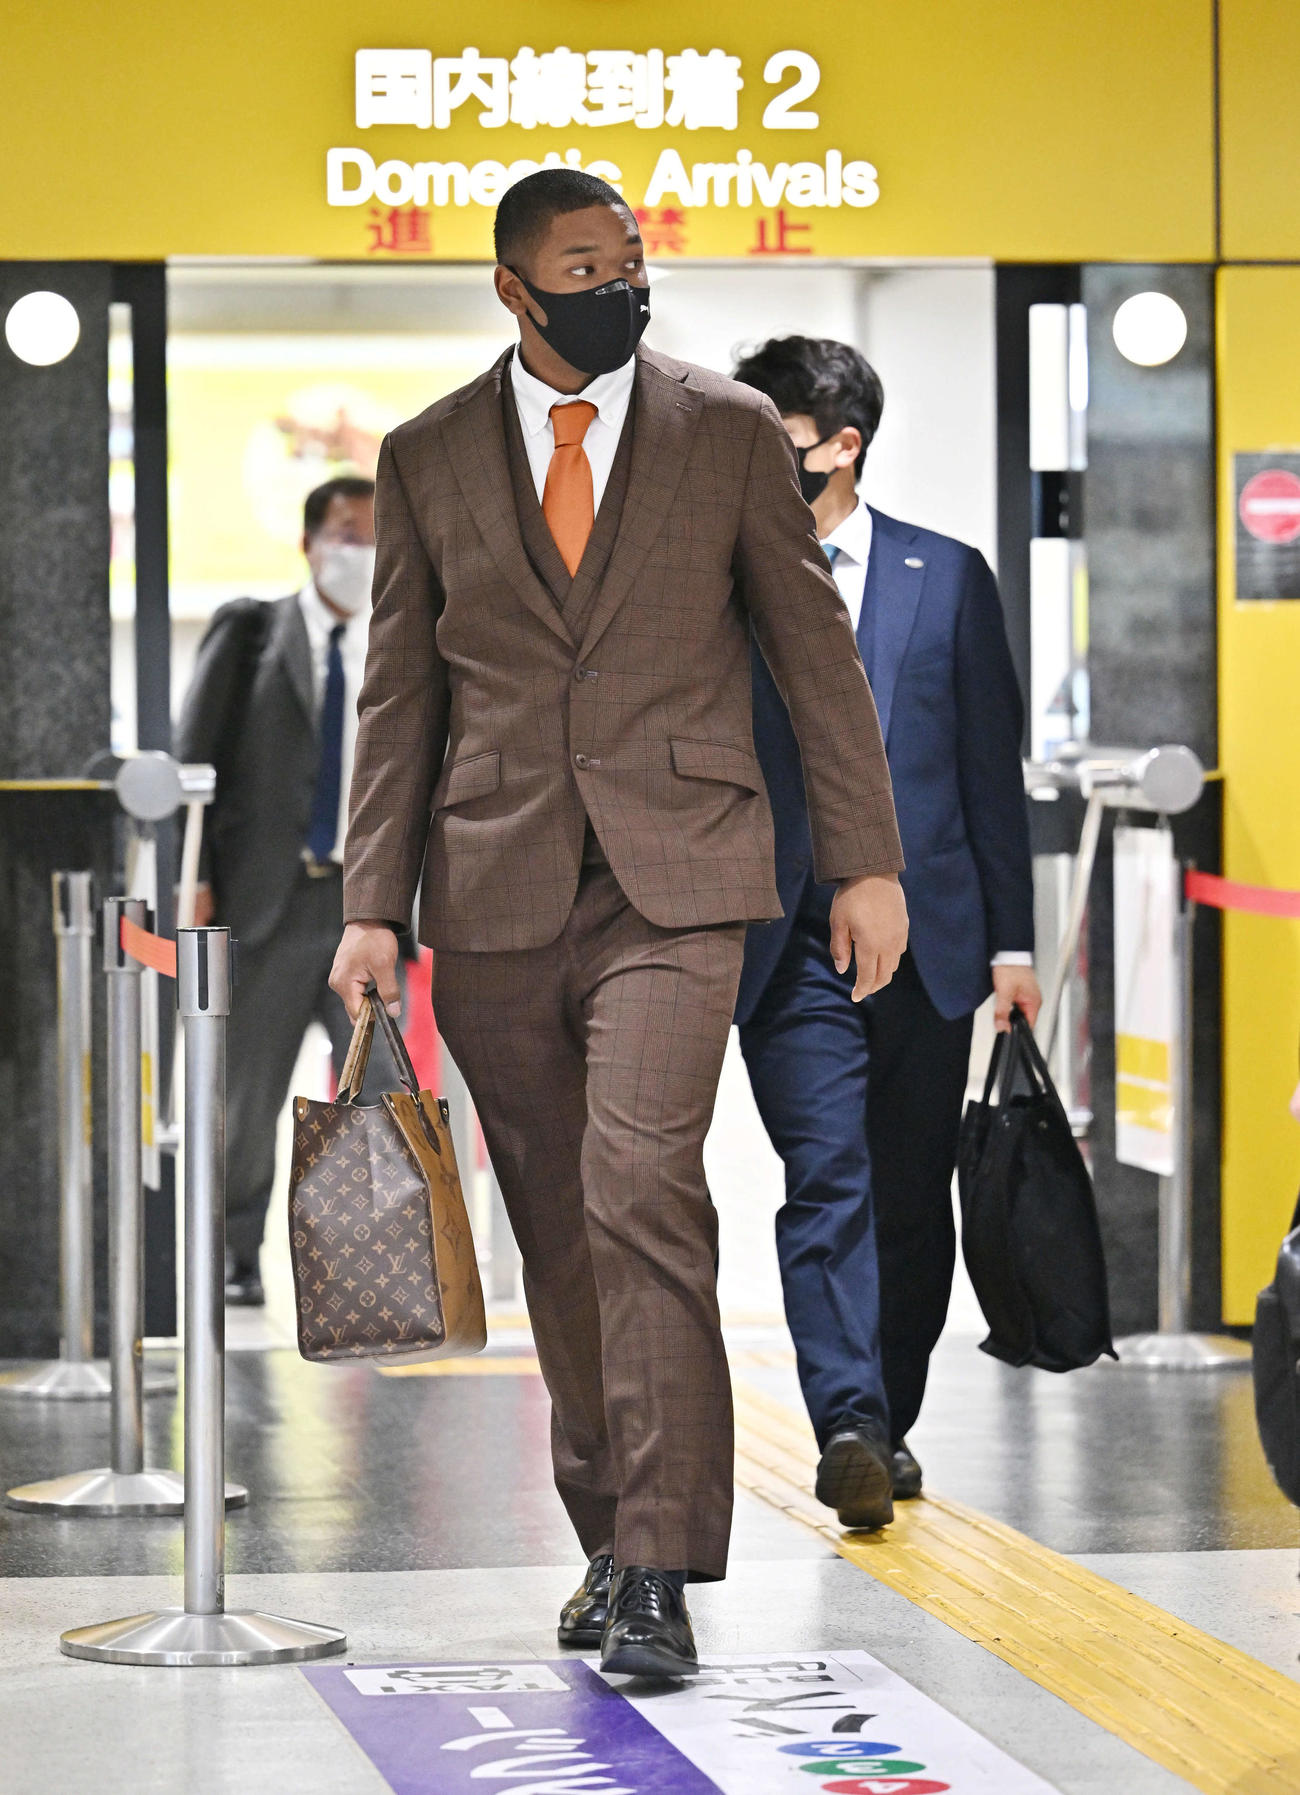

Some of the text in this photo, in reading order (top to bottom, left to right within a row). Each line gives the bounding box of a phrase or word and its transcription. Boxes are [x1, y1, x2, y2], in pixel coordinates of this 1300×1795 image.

[355, 47, 821, 130] 国内線到着 2
[644, 148, 880, 207] Arrivals
[682, 1674, 835, 1686] BUS
[380, 1683, 553, 1693] TAXI
[703, 1691, 879, 1738] バス
[811, 1743, 864, 1755] 2
[836, 1761, 888, 1774] 3
[858, 1780, 910, 1794] 4
